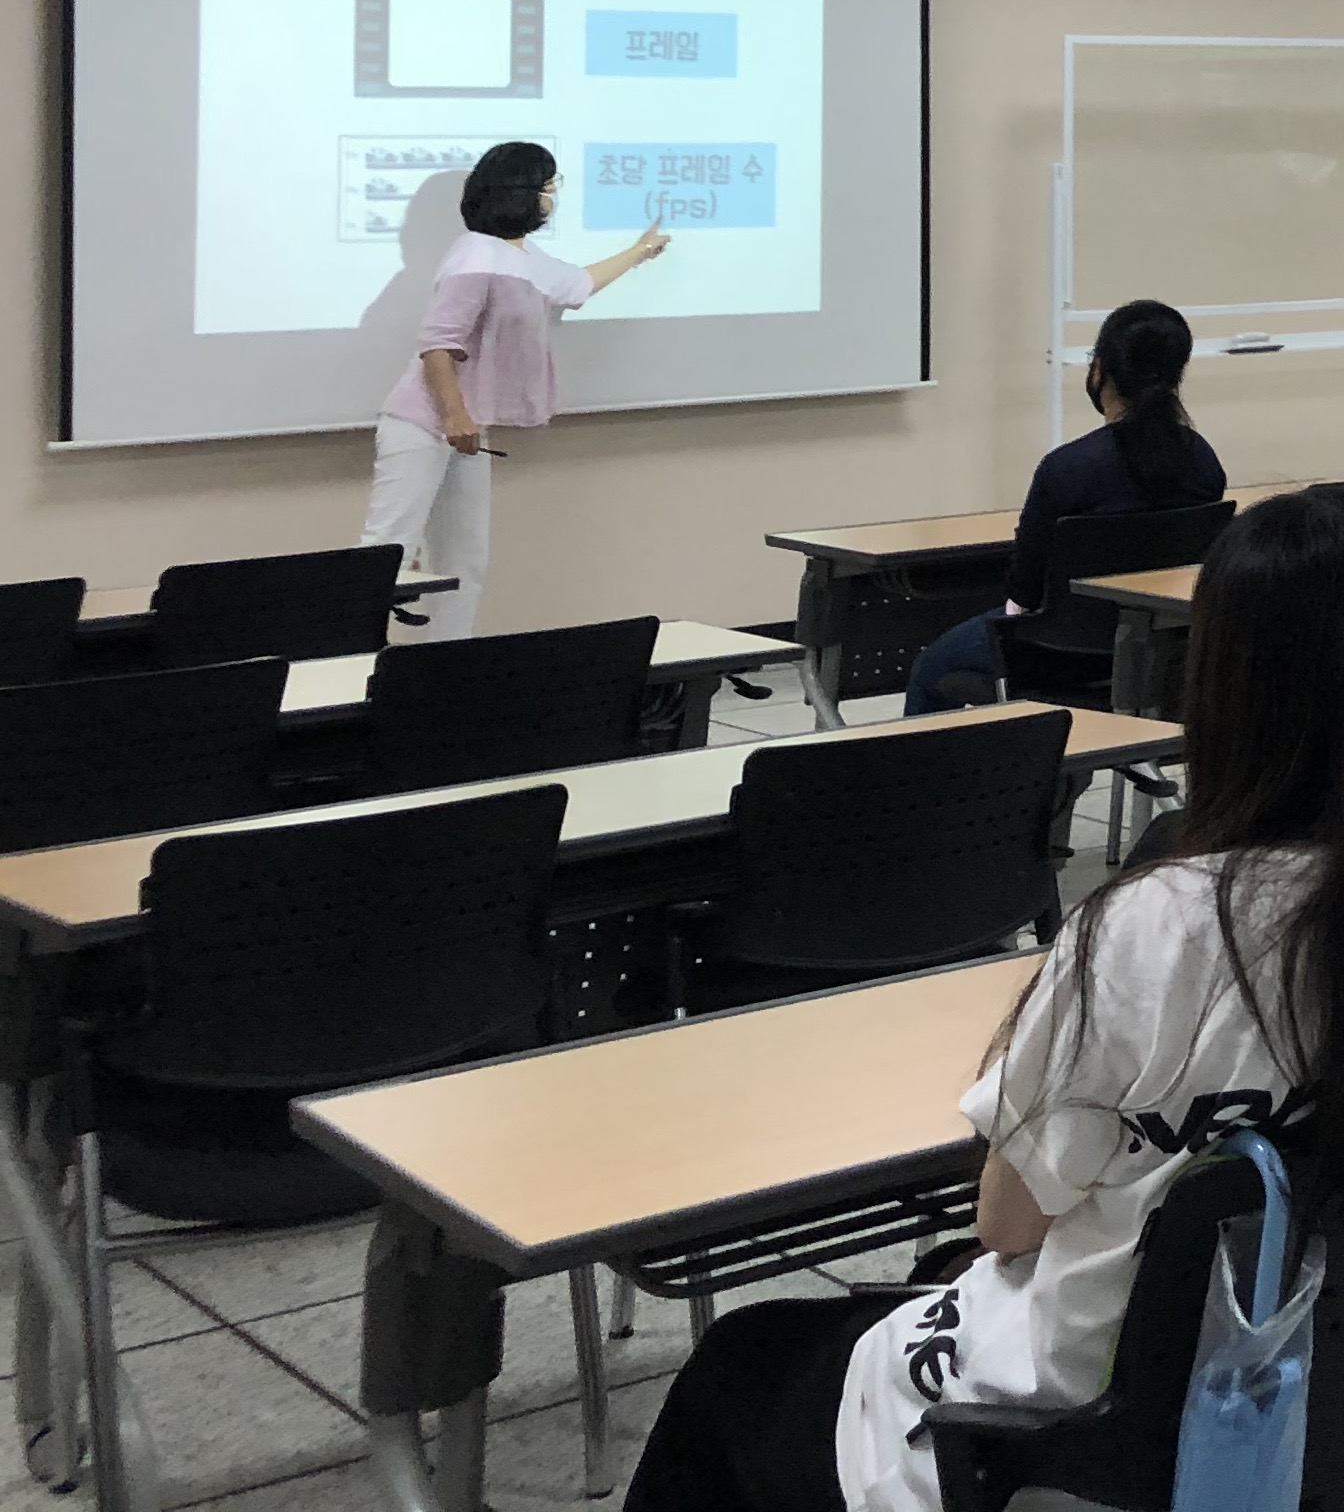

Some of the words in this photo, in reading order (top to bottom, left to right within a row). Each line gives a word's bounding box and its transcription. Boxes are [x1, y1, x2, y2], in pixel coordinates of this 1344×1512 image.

[625, 30, 699, 61] 프레임
[597, 154, 647, 185] 초당
[657, 154, 731, 185] 프레임
[742, 154, 764, 184] 수
[644, 190, 717, 221] (fps)
